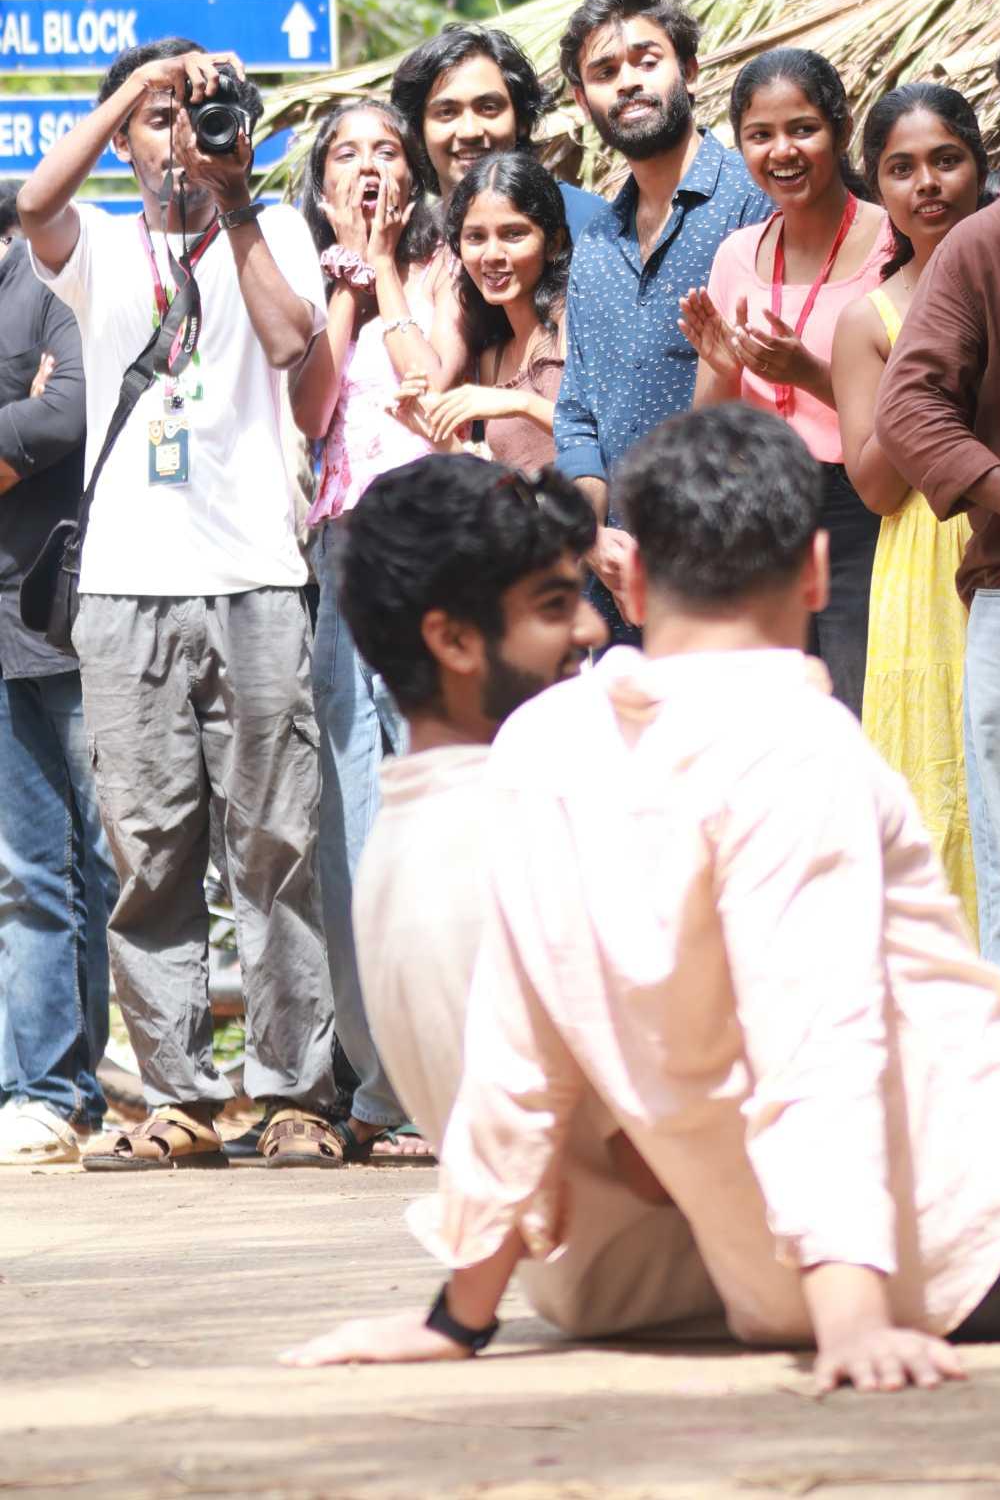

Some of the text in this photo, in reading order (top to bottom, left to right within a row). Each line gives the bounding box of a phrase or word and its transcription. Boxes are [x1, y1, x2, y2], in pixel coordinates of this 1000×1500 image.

[0, 9, 138, 55] AL BLOCK
[184, 317, 198, 353] Canon
